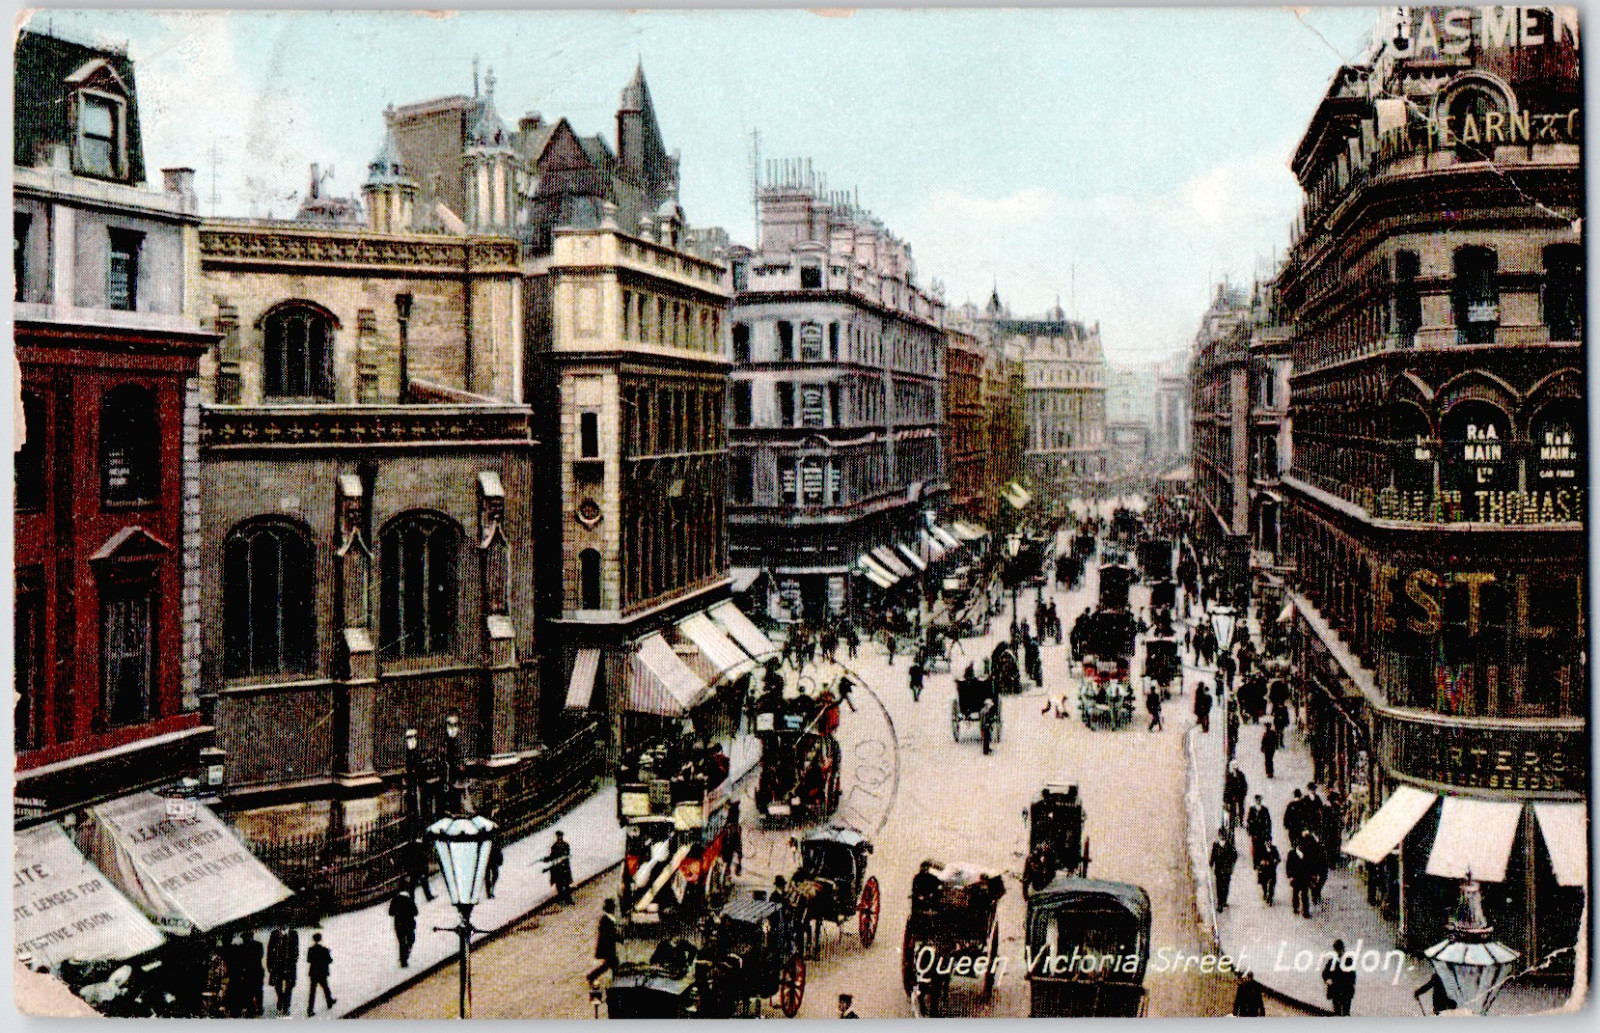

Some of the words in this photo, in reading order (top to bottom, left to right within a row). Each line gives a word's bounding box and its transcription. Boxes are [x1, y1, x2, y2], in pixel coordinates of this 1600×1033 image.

[1464, 444, 1502, 461] MAIN
[32, 888, 78, 912] LENSES
[78, 879, 104, 896] FOR
